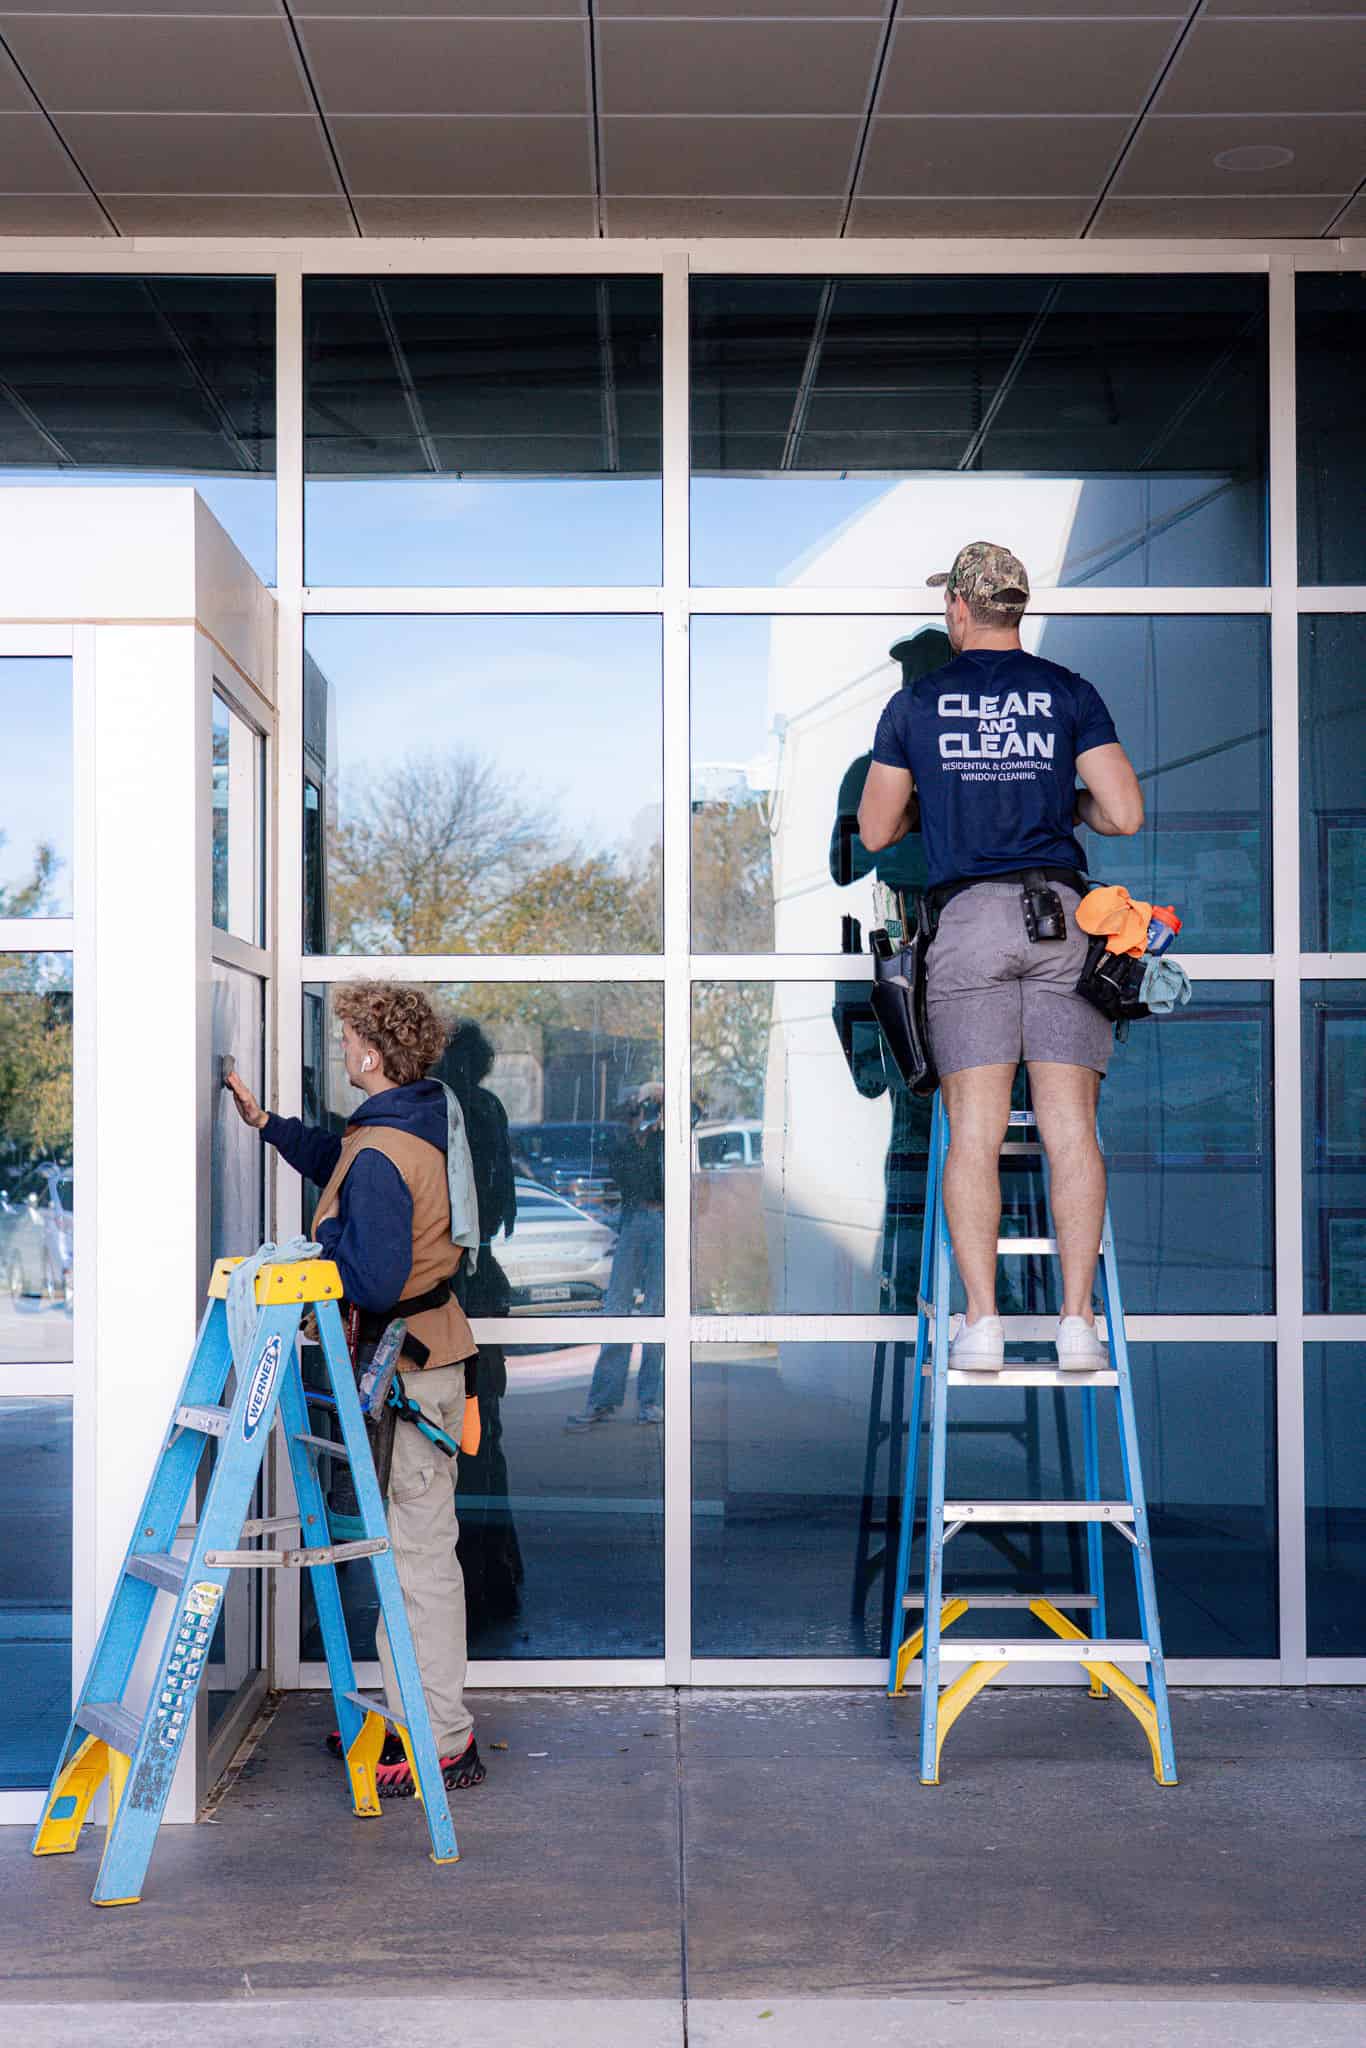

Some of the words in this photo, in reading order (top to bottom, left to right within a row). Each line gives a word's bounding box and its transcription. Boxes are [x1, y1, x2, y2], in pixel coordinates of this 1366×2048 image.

[938, 692, 1053, 719] CLEAR
[977, 718, 1016, 733] AND
[938, 732, 1055, 759] CLEAN
[942, 761, 991, 771] RESIDENTIAL
[992, 761, 1000, 770] &
[1000, 761, 1052, 770] COMMERCIAL
[960, 772, 997, 781] WINDOW
[998, 771, 1036, 781] CLEANING
[249, 1352, 276, 1418] WERNER
